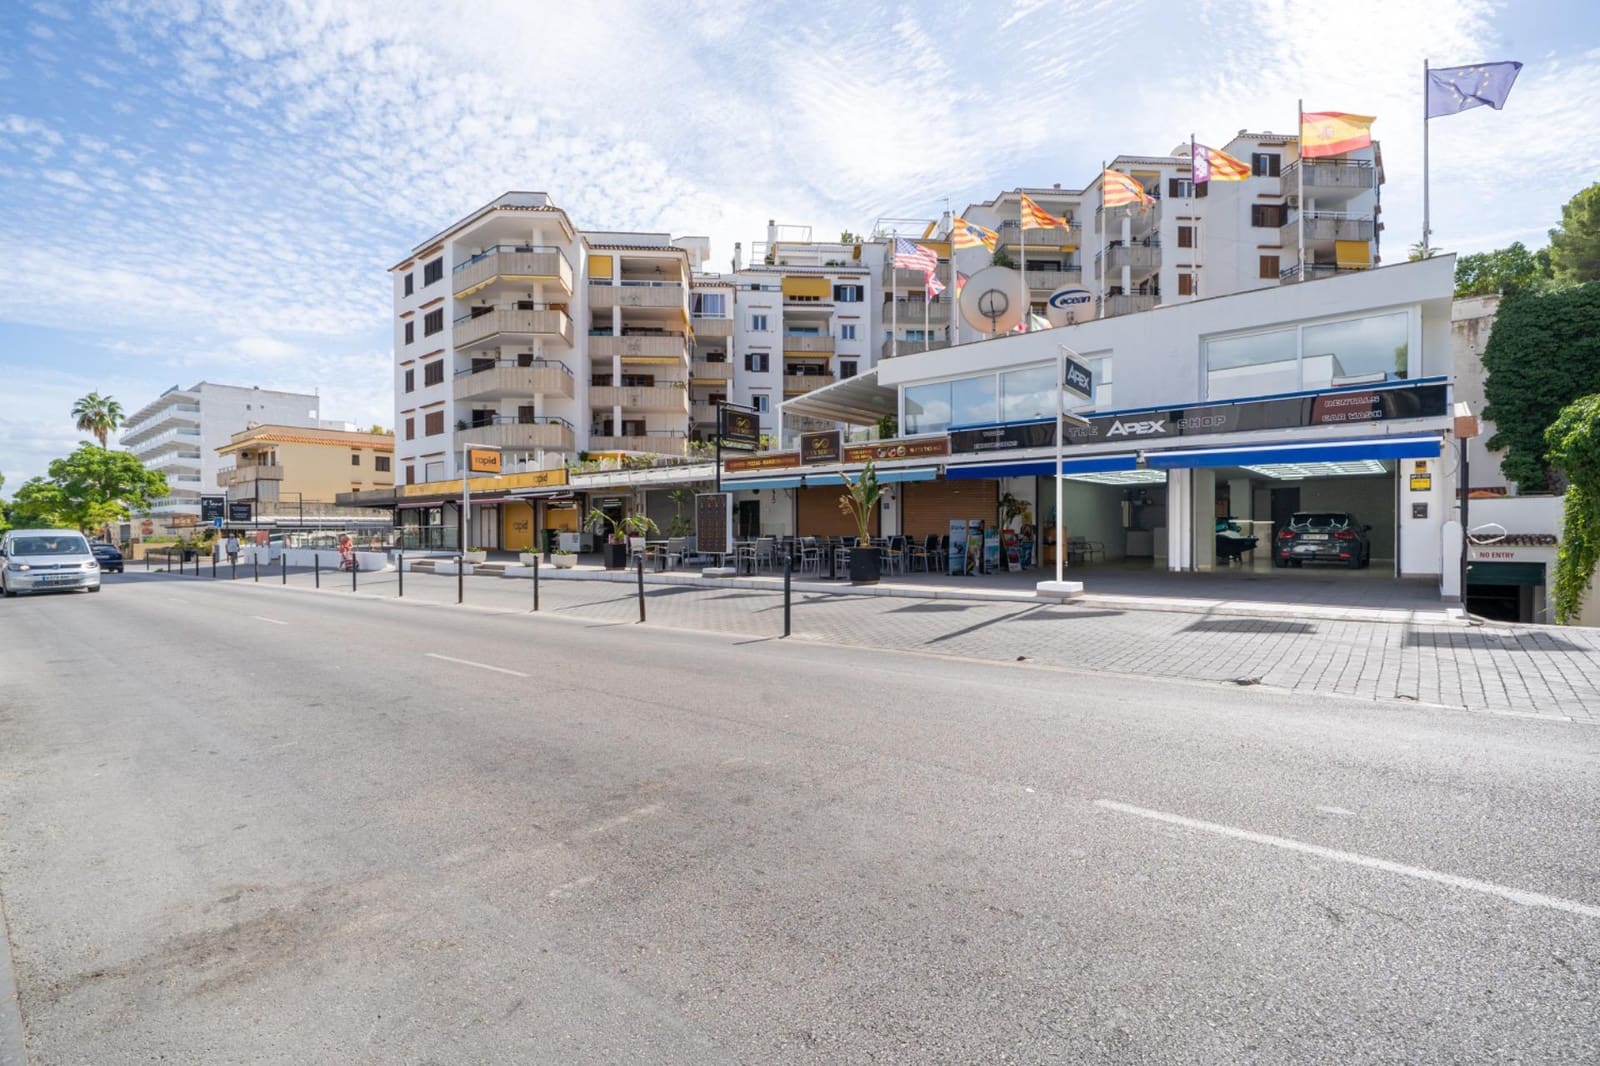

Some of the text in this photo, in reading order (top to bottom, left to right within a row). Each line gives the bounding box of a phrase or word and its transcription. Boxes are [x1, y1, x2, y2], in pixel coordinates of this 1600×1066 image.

[1067, 363, 1090, 391] APEX
[1068, 415, 1226, 437] THE APEX SHOP
[1491, 551, 1515, 559] ENTRY
